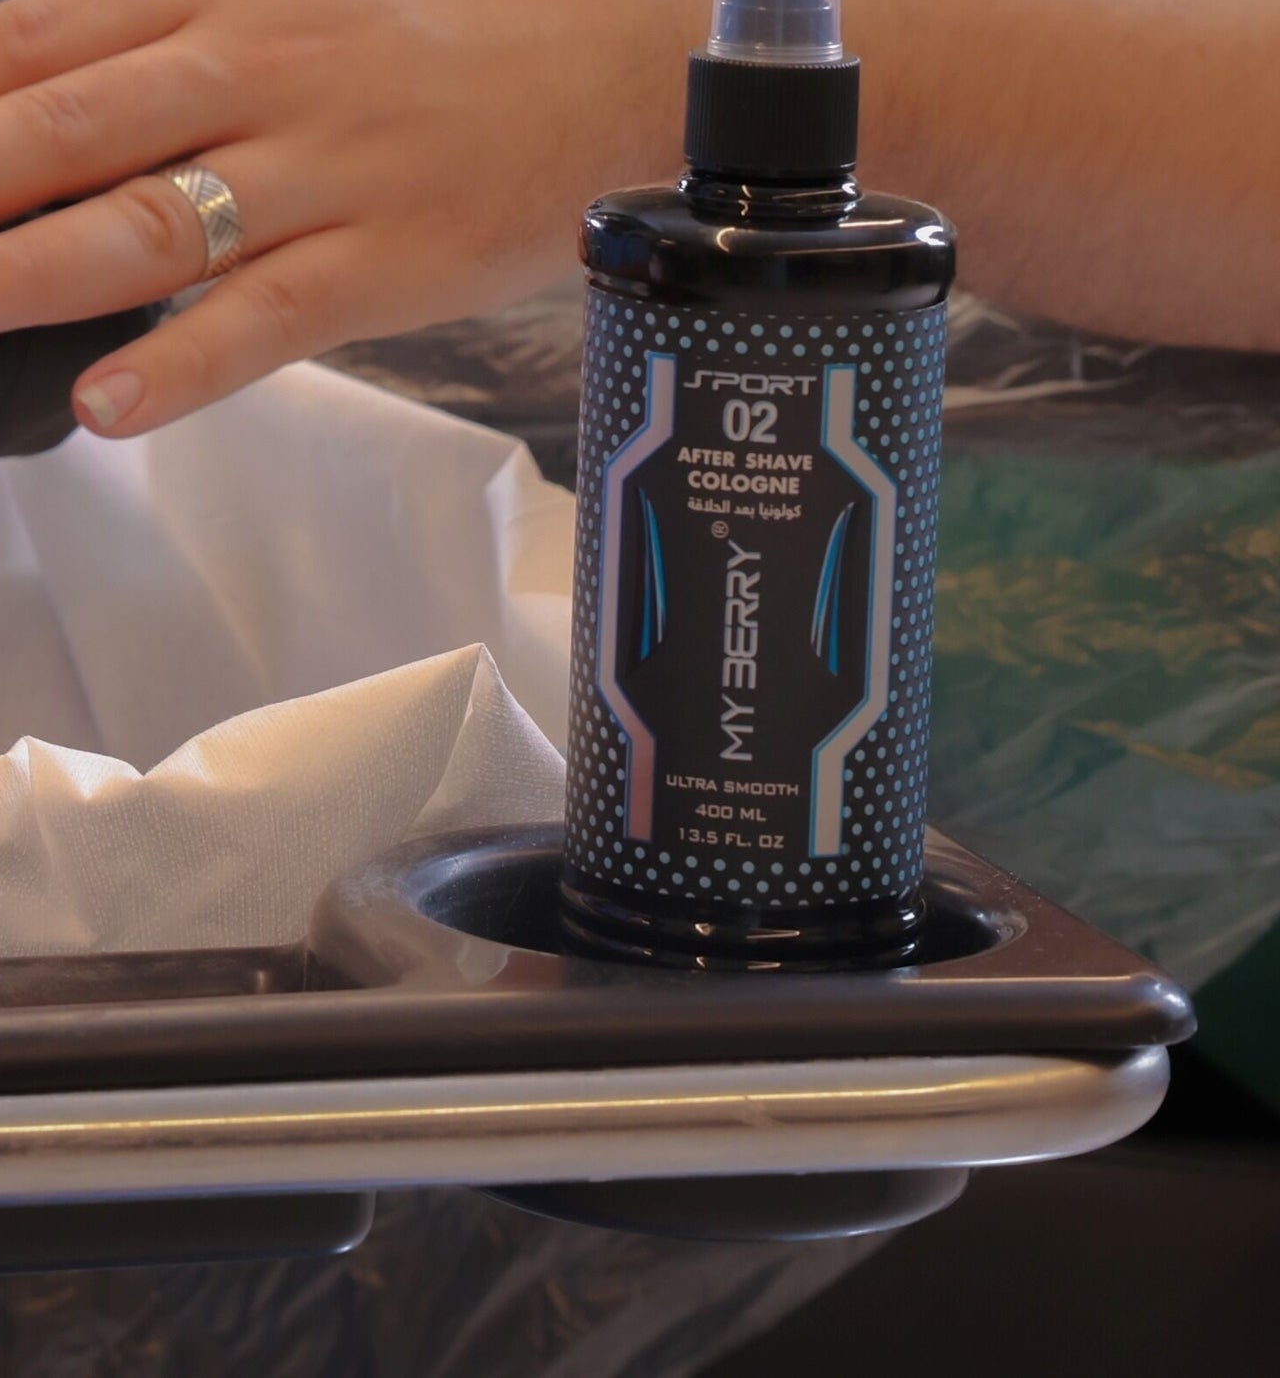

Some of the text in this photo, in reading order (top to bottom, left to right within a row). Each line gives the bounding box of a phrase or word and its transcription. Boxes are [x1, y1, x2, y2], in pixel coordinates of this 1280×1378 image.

[683, 370, 818, 395] SPORT
[722, 399, 778, 444] 02
[677, 447, 813, 471] AFTER SHAVE
[687, 470, 801, 495] COLOGNE
[687, 496, 802, 520] كولونيا بعد الحلاقة
[666, 774, 799, 796] ULTRA SMOOTH
[695, 803, 767, 822] 400 ML
[679, 828, 785, 849] 13.5 FL. OZ
